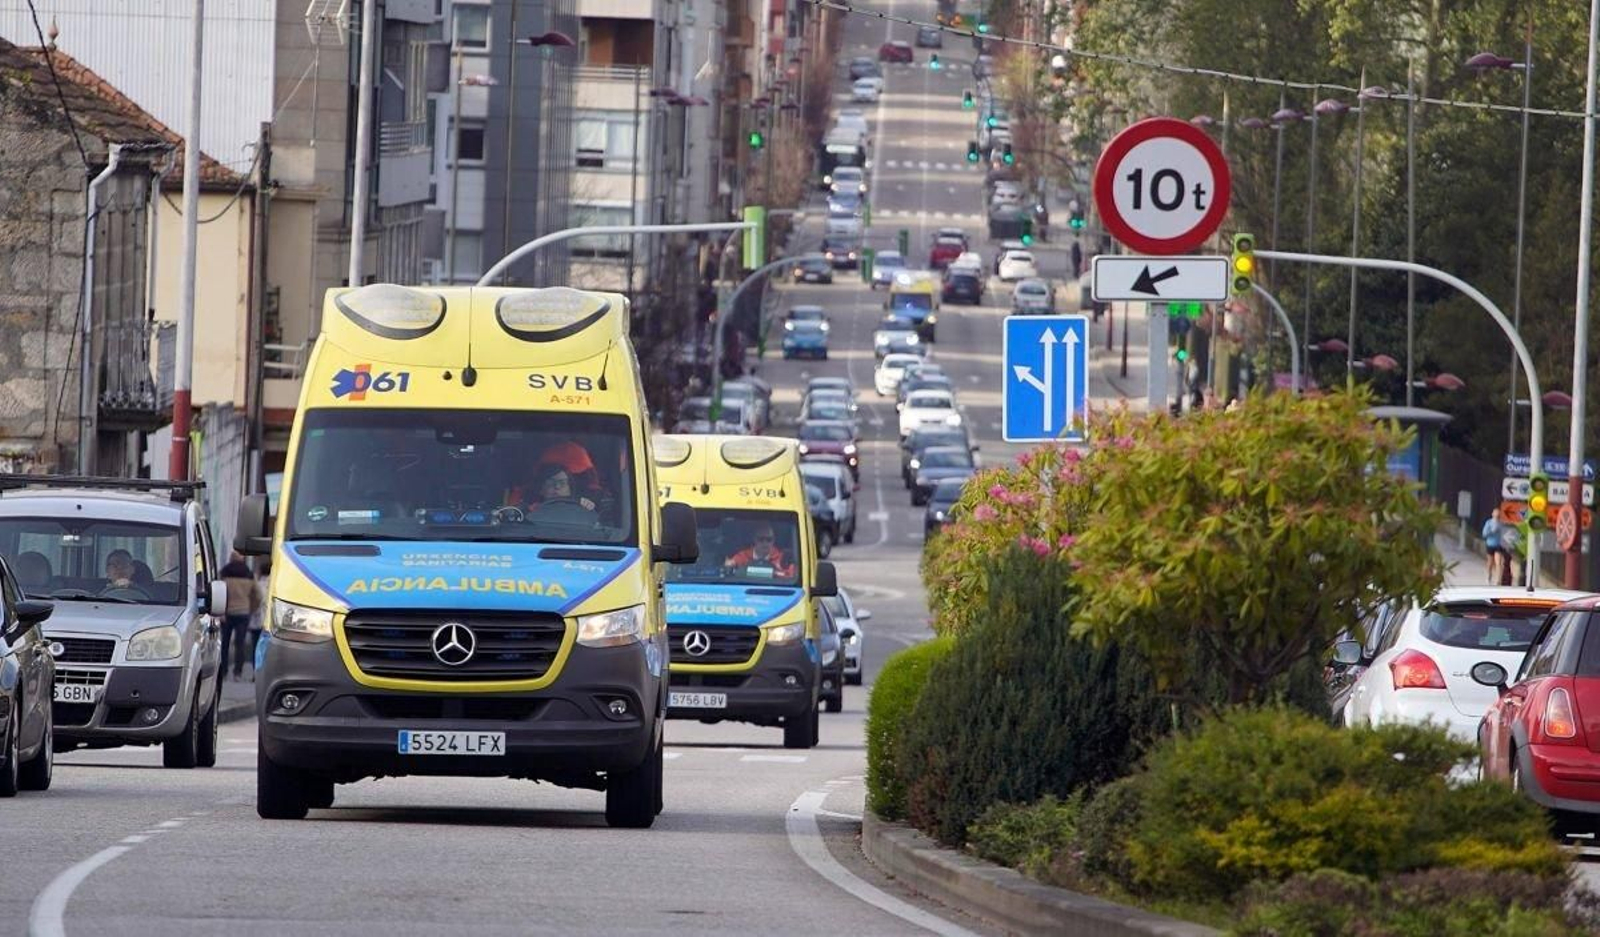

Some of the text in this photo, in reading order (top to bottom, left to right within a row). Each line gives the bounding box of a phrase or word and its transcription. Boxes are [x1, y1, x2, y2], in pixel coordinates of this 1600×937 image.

[1126, 168, 1206, 211] 10 t
[352, 371, 410, 392] 061
[528, 373, 593, 391] SVB
[740, 487, 776, 498] SVB
[63, 685, 91, 701] GBN
[412, 733, 501, 752] 5524 LFX
